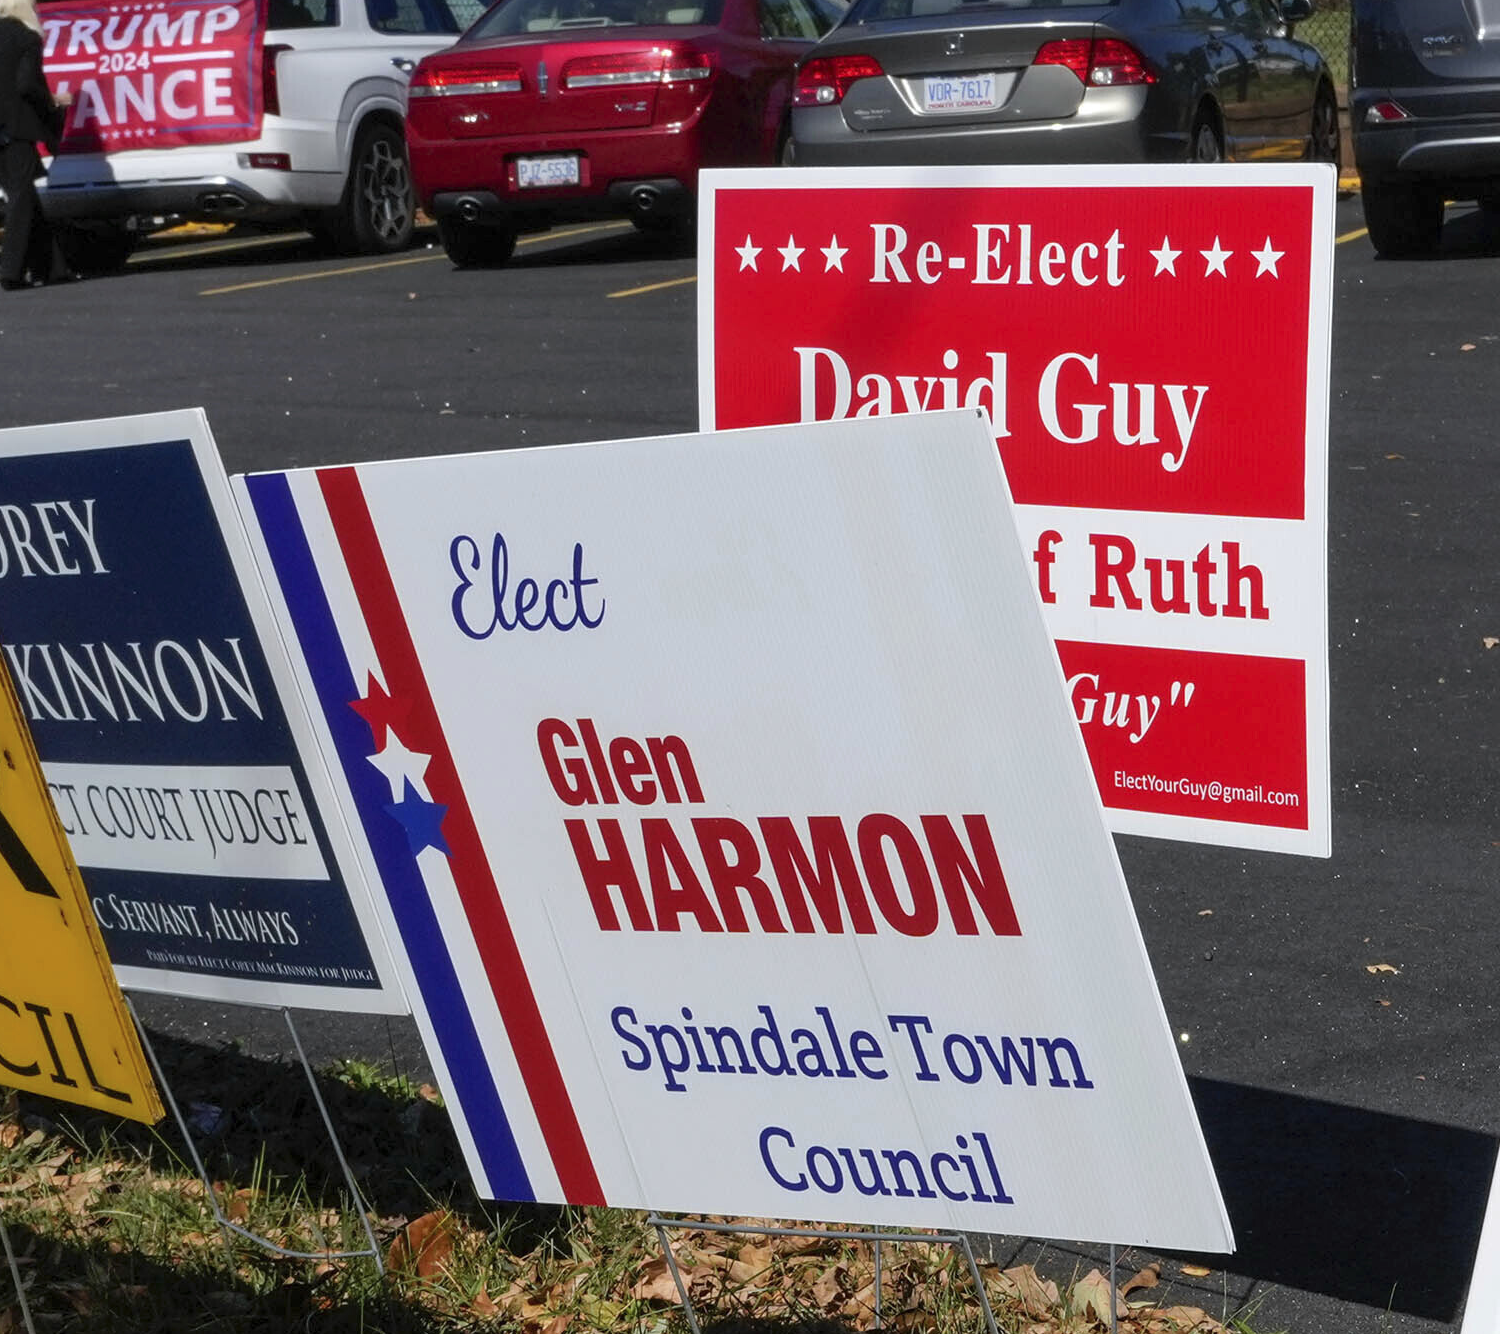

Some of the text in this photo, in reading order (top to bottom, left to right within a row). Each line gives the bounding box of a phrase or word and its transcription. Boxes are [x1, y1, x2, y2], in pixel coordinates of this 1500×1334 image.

[43, 5, 240, 58] TRUMP
[98, 51, 150, 74] 2024
[55, 68, 236, 129] ANCE
[870, 223, 1125, 288] Re-Elect
[794, 346, 1209, 472] David Guy
[450, 532, 605, 640] Elect
[1033, 529, 1269, 620] f Ruth
[3, 638, 264, 723] KINNON
[537, 718, 705, 807] Glen
[1113, 769, 1299, 806] ElectYourGuy@gmail.com
[86, 783, 198, 842] COURT
[190, 788, 308, 860] JUDGE
[564, 812, 1022, 937] HARMON
[212, 904, 300, 947] ALWAYS
[611, 1006, 1094, 1092] Spindale Town
[759, 1126, 1014, 1205] Council
